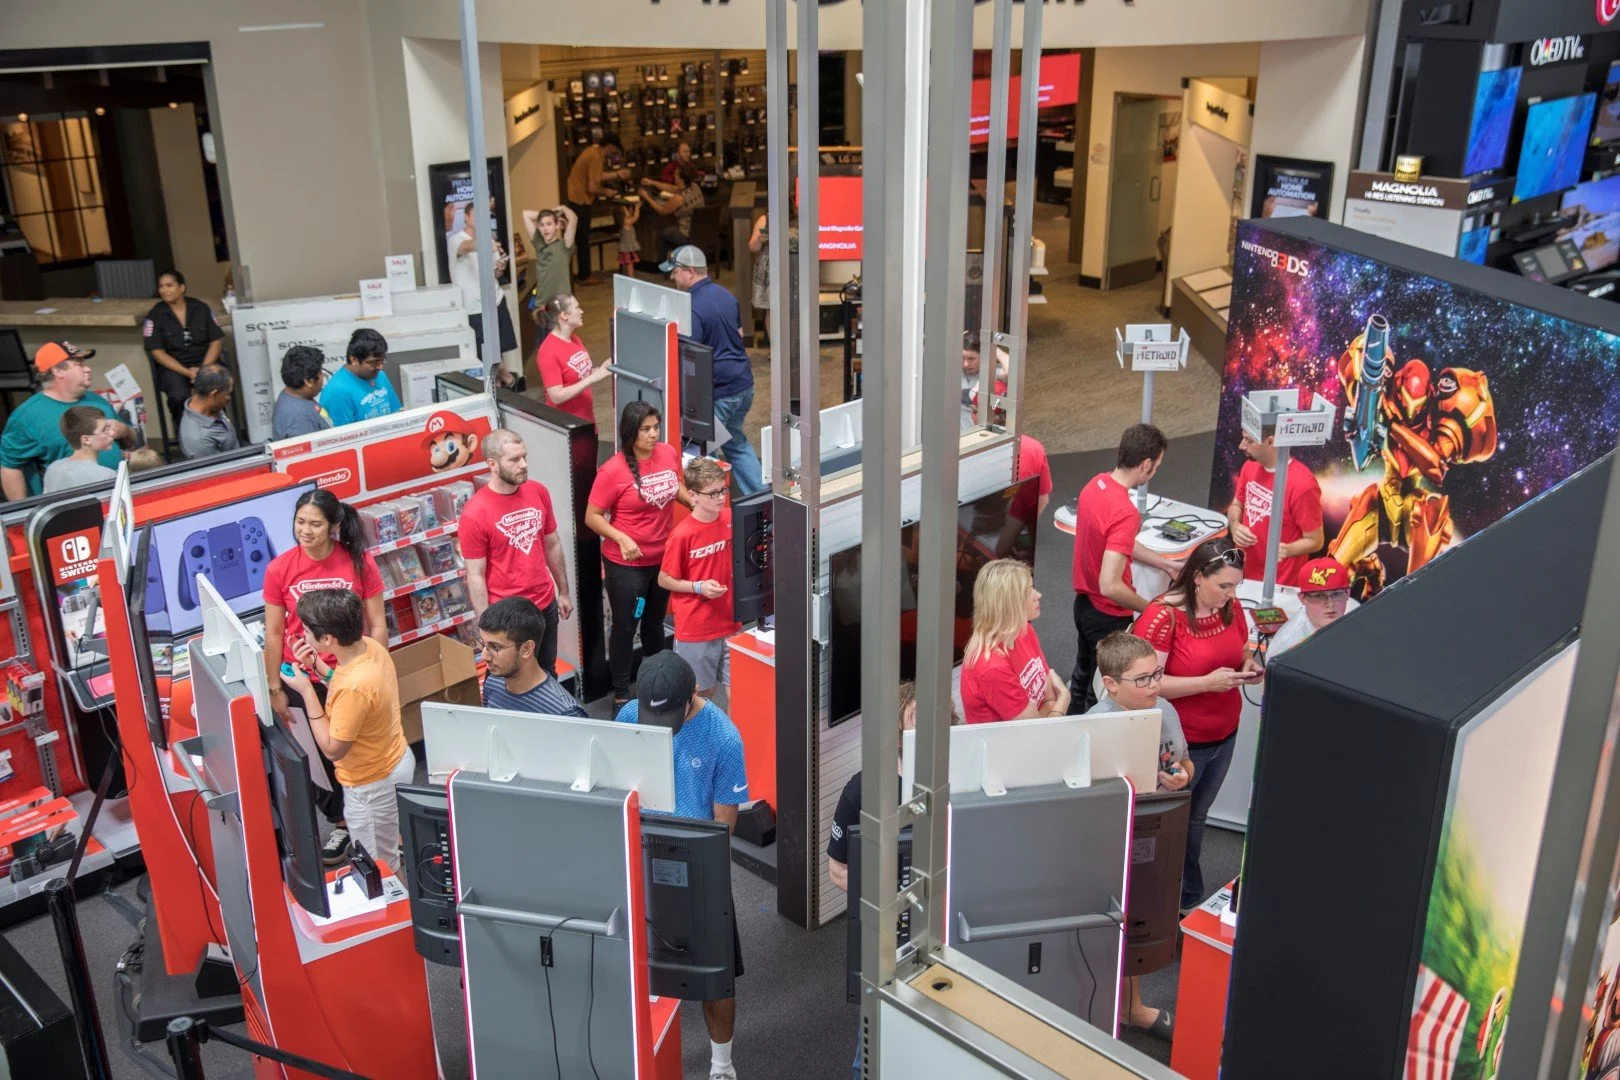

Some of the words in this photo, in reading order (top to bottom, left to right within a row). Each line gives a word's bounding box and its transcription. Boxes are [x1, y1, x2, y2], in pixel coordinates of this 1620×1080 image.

[1530, 37, 1563, 66] OLED
[1563, 35, 1582, 60] TV
[1267, 188, 1316, 200] AUTOMATION
[1280, 183, 1304, 193] HOME
[1371, 181, 1439, 197] MAGNOLIA
[445, 193, 474, 203] AUTOMA
[1241, 240, 1278, 262] NINTENDO
[1277, 252, 1310, 277] 3DS
[248, 339, 267, 348] BRA
[1136, 350, 1177, 361] METROID
[1280, 422, 1325, 435] METROID
[317, 438, 339, 448] SWITCH
[339, 433, 359, 443] GAMES
[317, 471, 347, 485] tendo
[642, 472, 672, 485] Nintendo
[504, 510, 536, 524] Nintendo
[689, 540, 726, 558] TEAM
[59, 558, 99, 571] NINTENDO
[301, 581, 342, 590] Nintendo
